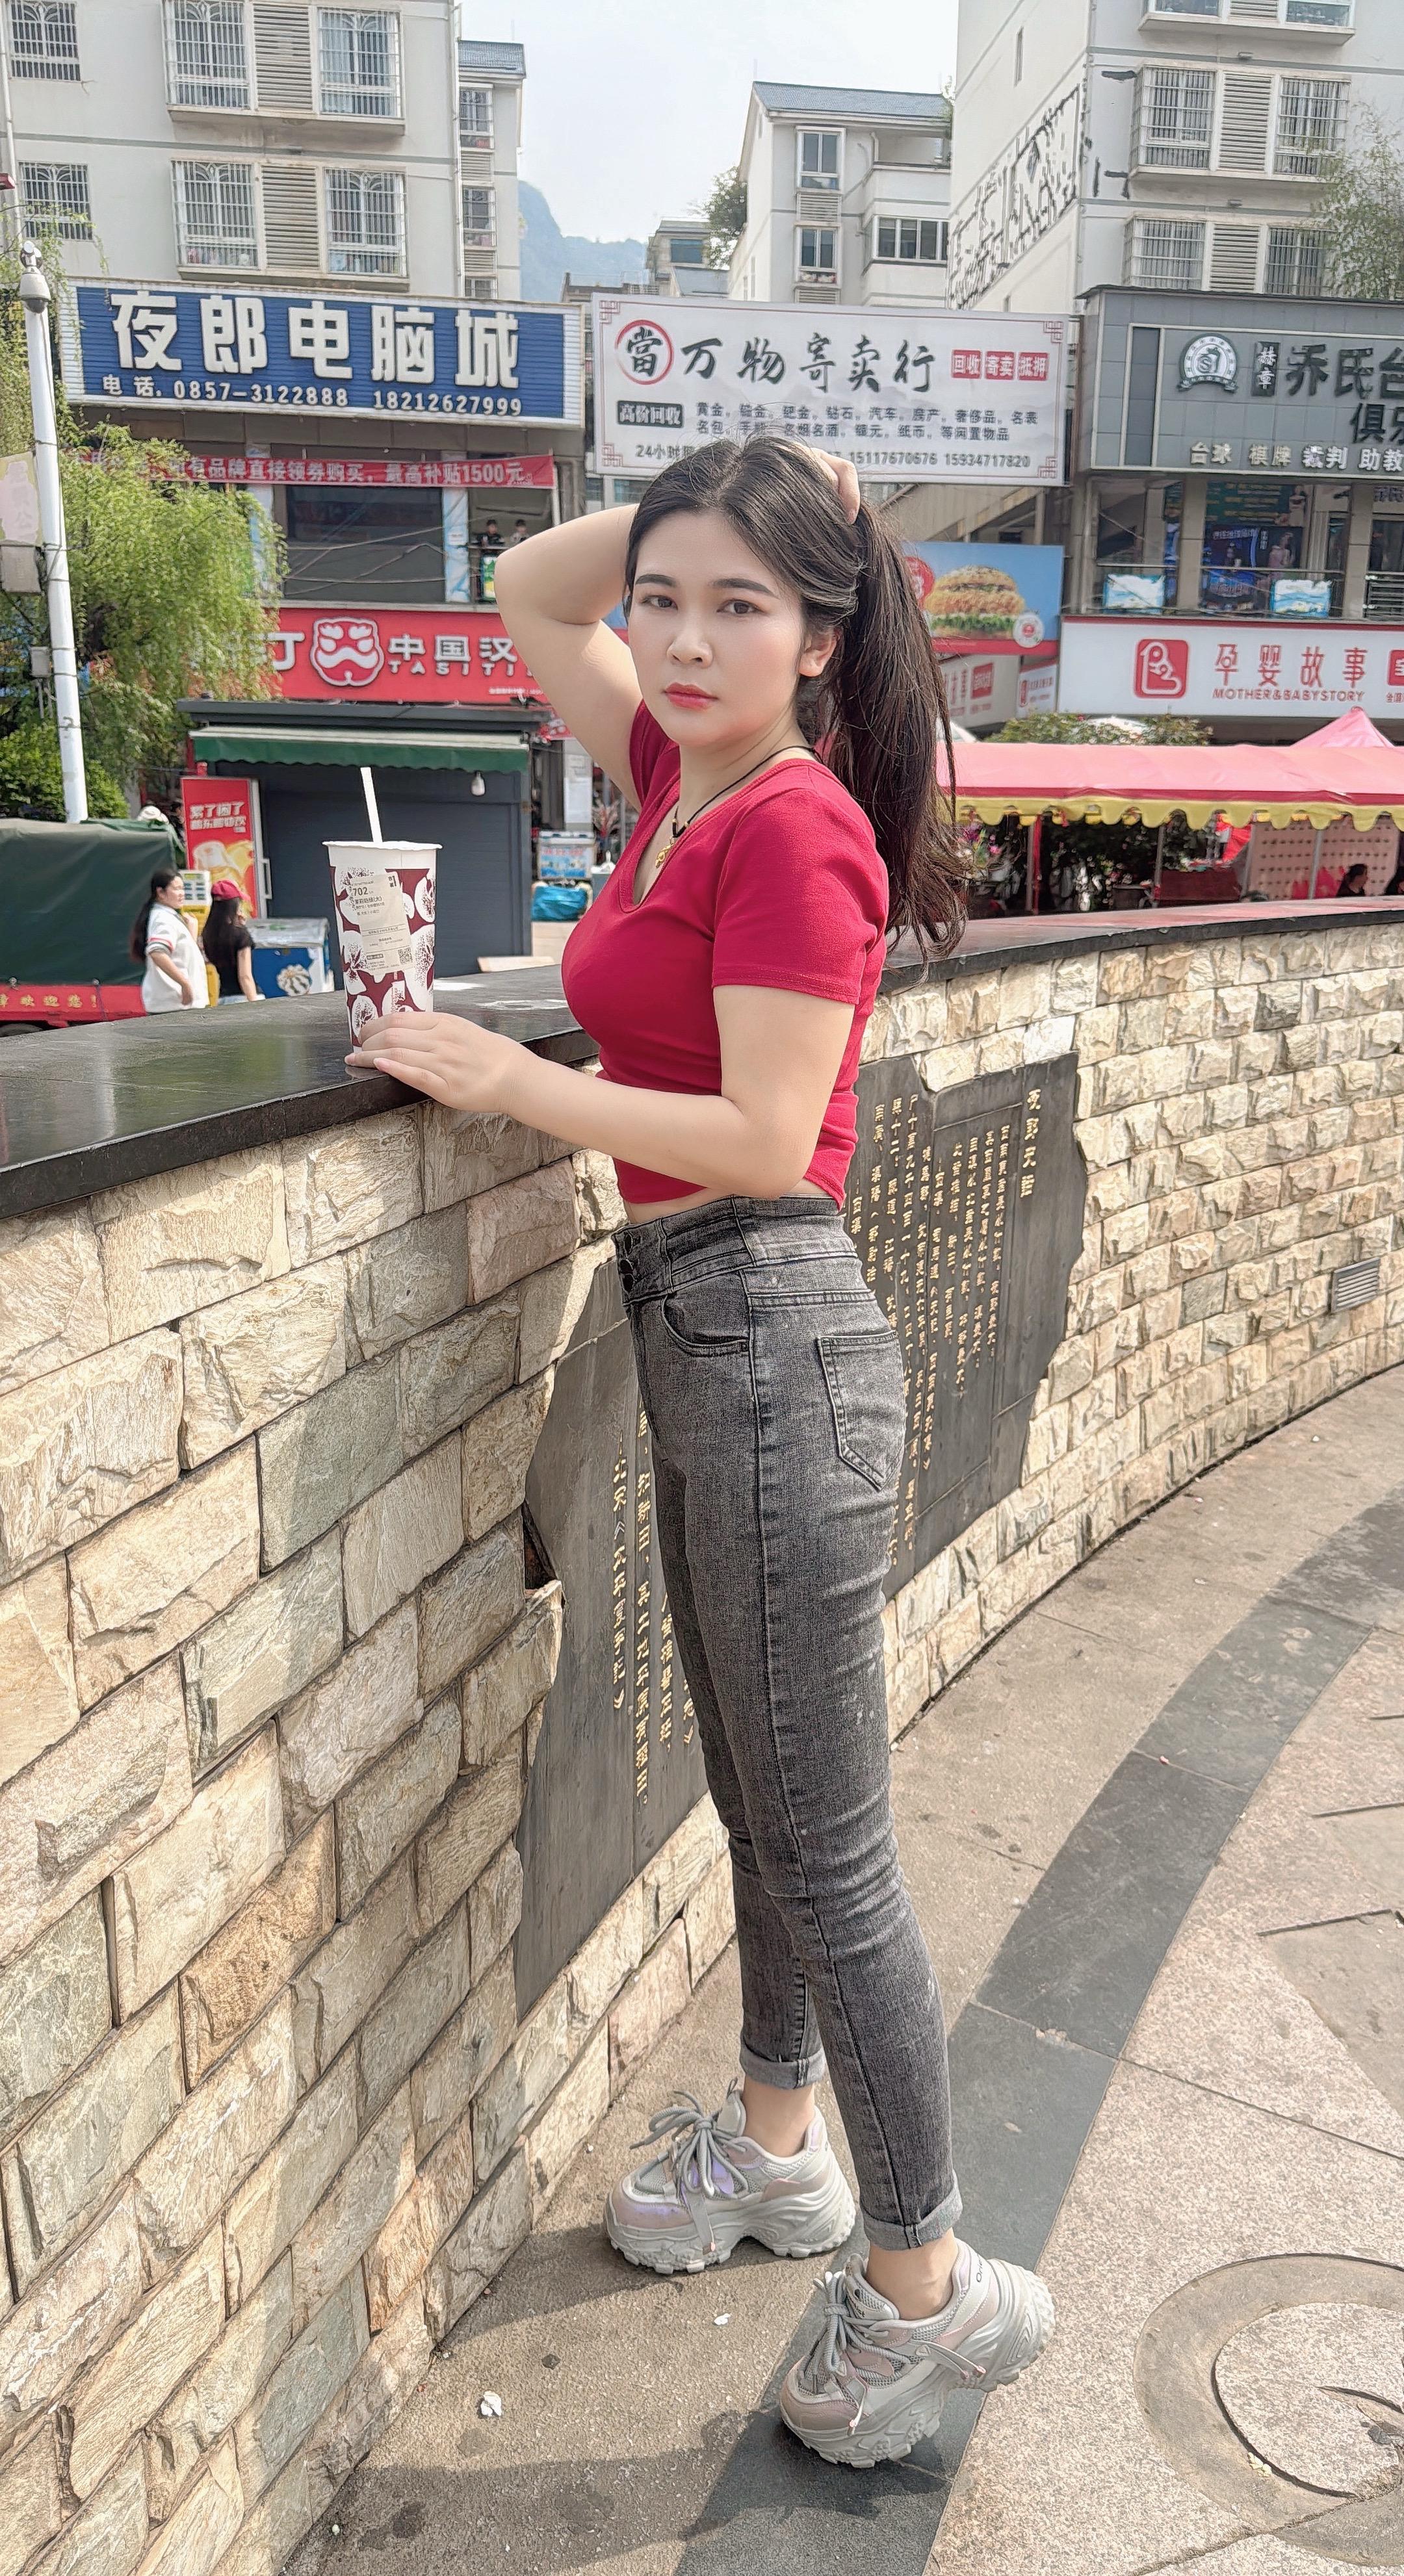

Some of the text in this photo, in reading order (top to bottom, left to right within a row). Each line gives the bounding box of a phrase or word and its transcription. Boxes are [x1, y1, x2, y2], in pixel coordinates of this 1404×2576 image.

[110, 290, 519, 389] 夜郎电脑城
[625, 329, 937, 393] 當 万物寄卖行
[954, 354, 1048, 378] 回收 寄卖 抵押
[1257, 346, 1277, 390] 赫章
[1284, 342, 1404, 401] 乔氏台
[174, 379, 348, 407] 0857-3122888
[372, 391, 522, 417] 18212627999
[619, 403, 681, 425] 高价回收
[1190, 441, 1232, 465] 台球
[1248, 443, 1292, 468] 棋牌
[1357, 447, 1404, 473] 助教
[388, 633, 518, 663] 中国汉
[388, 659, 533, 677] TASITI
[1213, 643, 1368, 689] 孕婴故事
[1212, 688, 1366, 702] MOTHER&BABYSTORY
[352, 886, 369, 897] 702
